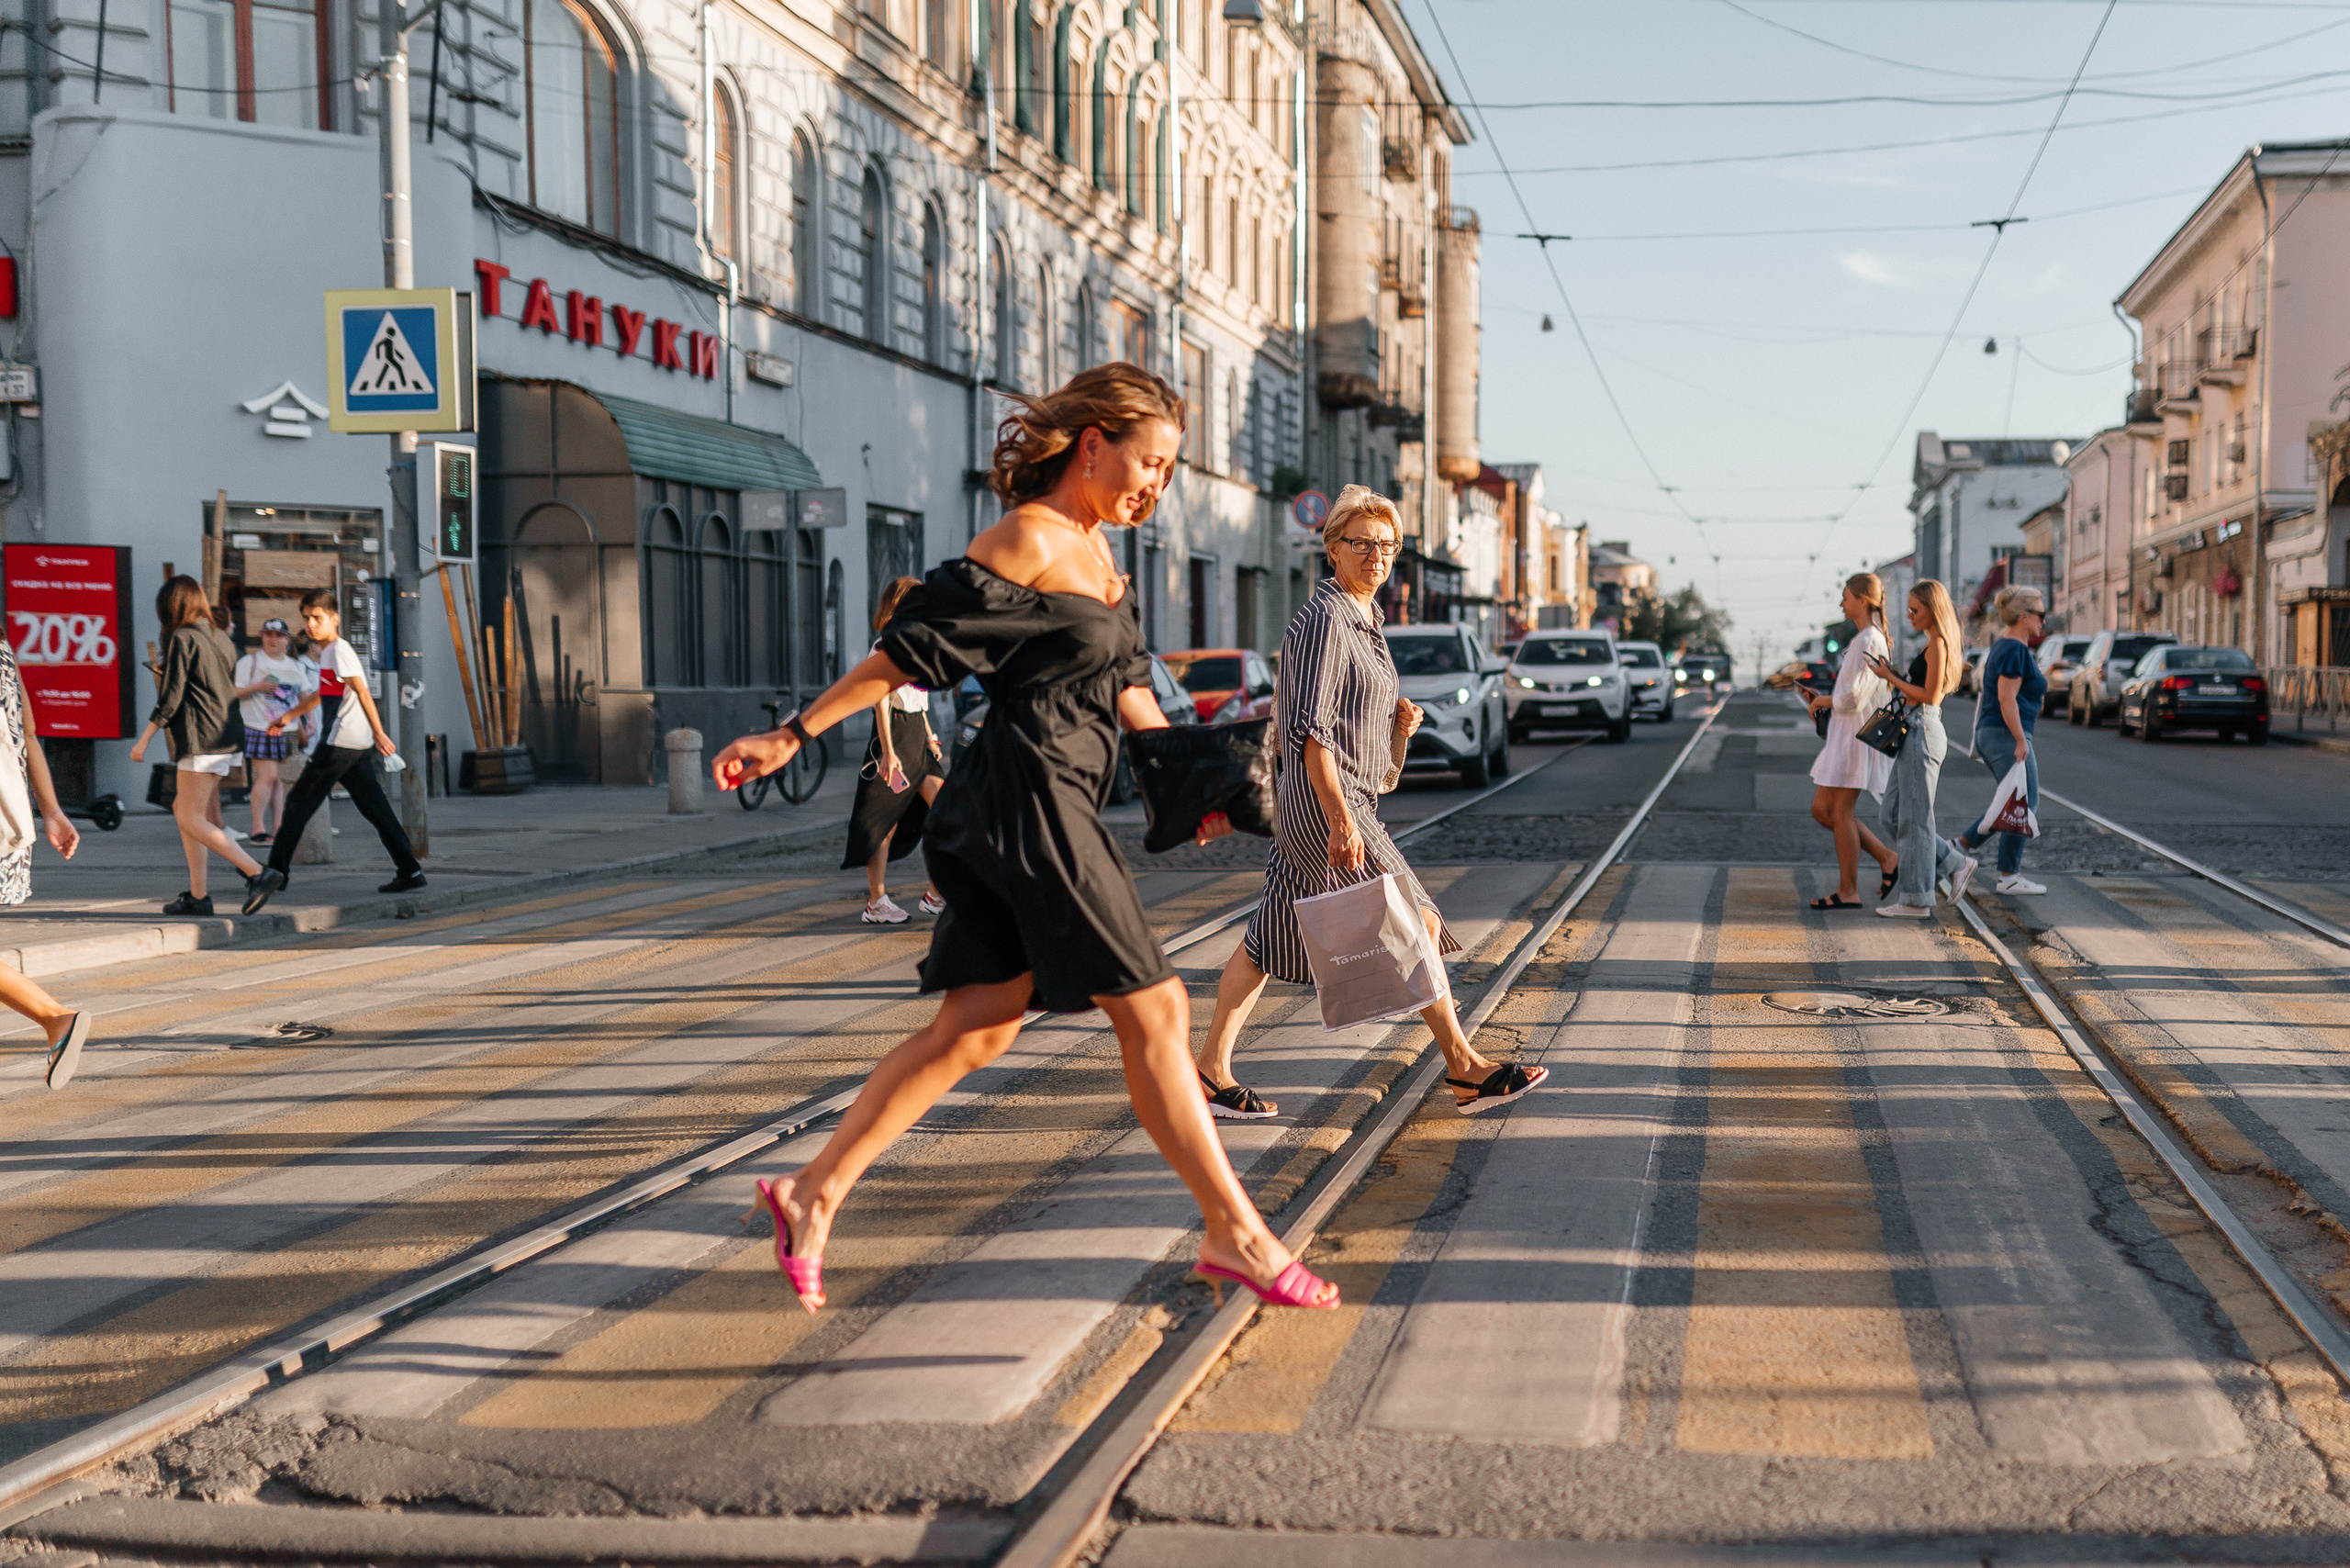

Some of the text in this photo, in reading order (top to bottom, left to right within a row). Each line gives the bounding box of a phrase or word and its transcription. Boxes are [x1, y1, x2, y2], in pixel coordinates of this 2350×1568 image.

[474, 258, 719, 379] ТАНУКИ
[2322, 588, 2350, 599] РЕМ
[16, 611, 116, 663] 20%
[1329, 945, 1390, 966] Tamaris
